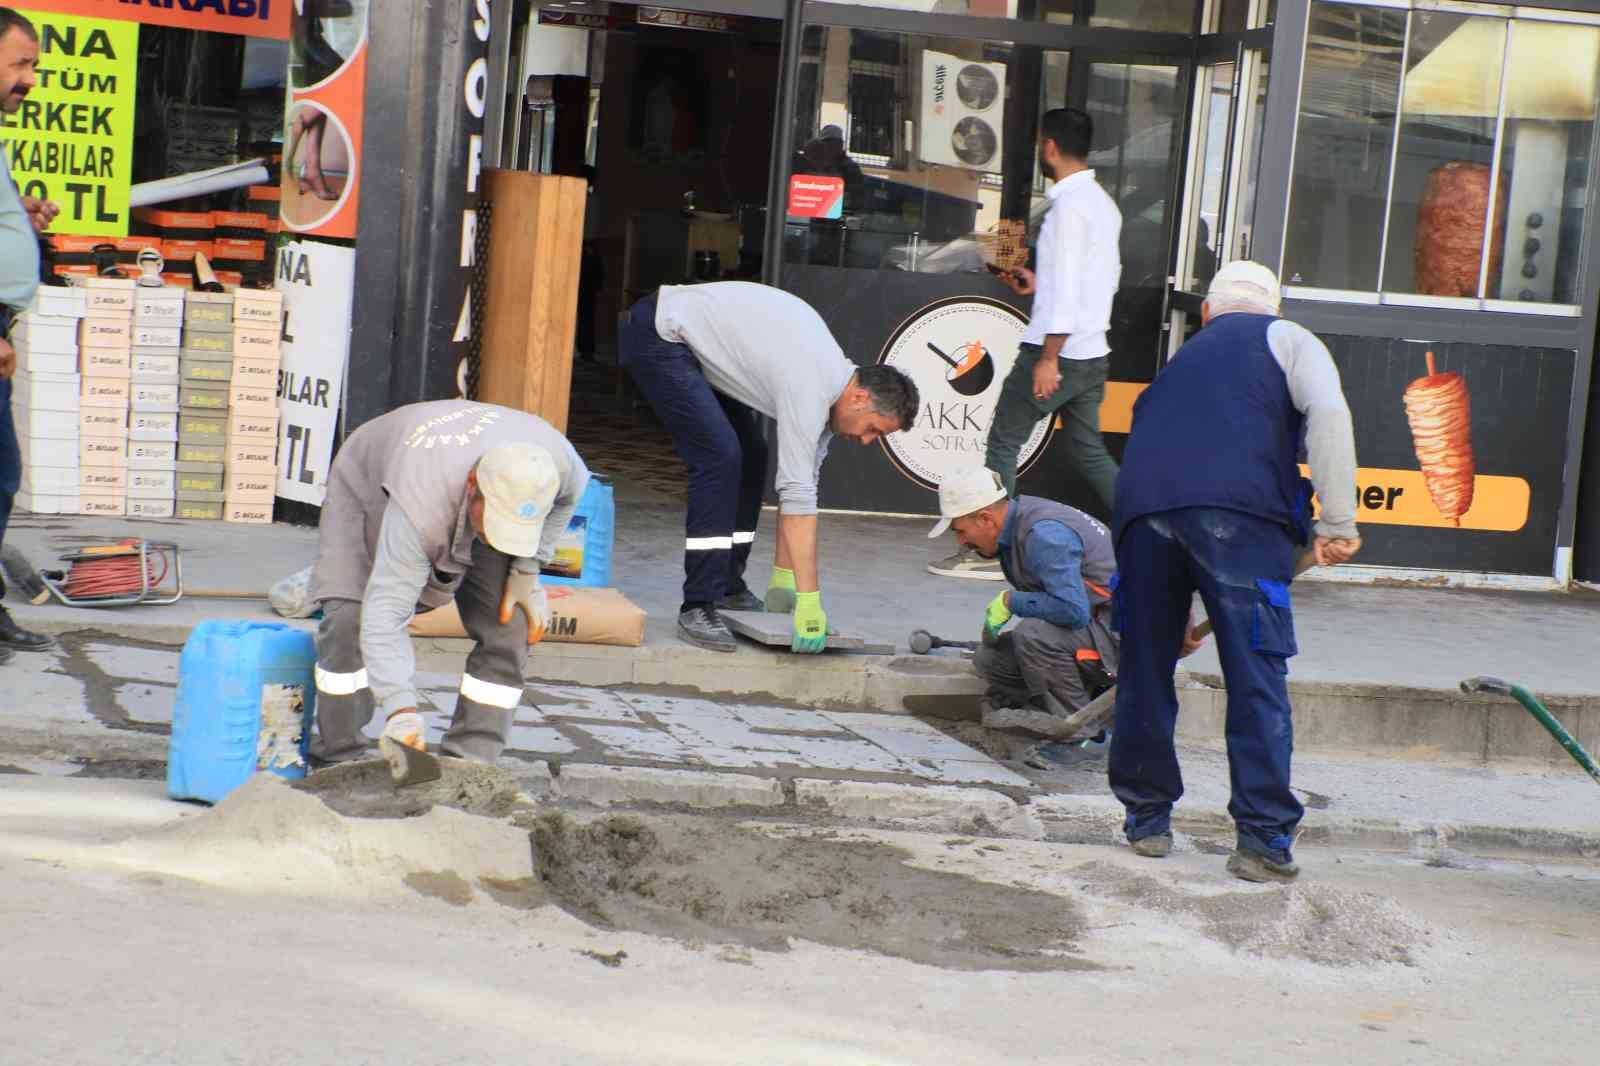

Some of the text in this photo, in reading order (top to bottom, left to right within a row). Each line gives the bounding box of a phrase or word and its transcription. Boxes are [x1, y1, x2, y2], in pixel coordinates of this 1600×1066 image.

[42, 24, 117, 60] NA
[34, 67, 117, 94] TÜM
[0, 139, 114, 178] KABILAR
[65, 182, 119, 222] TL
[279, 249, 312, 286] NA
